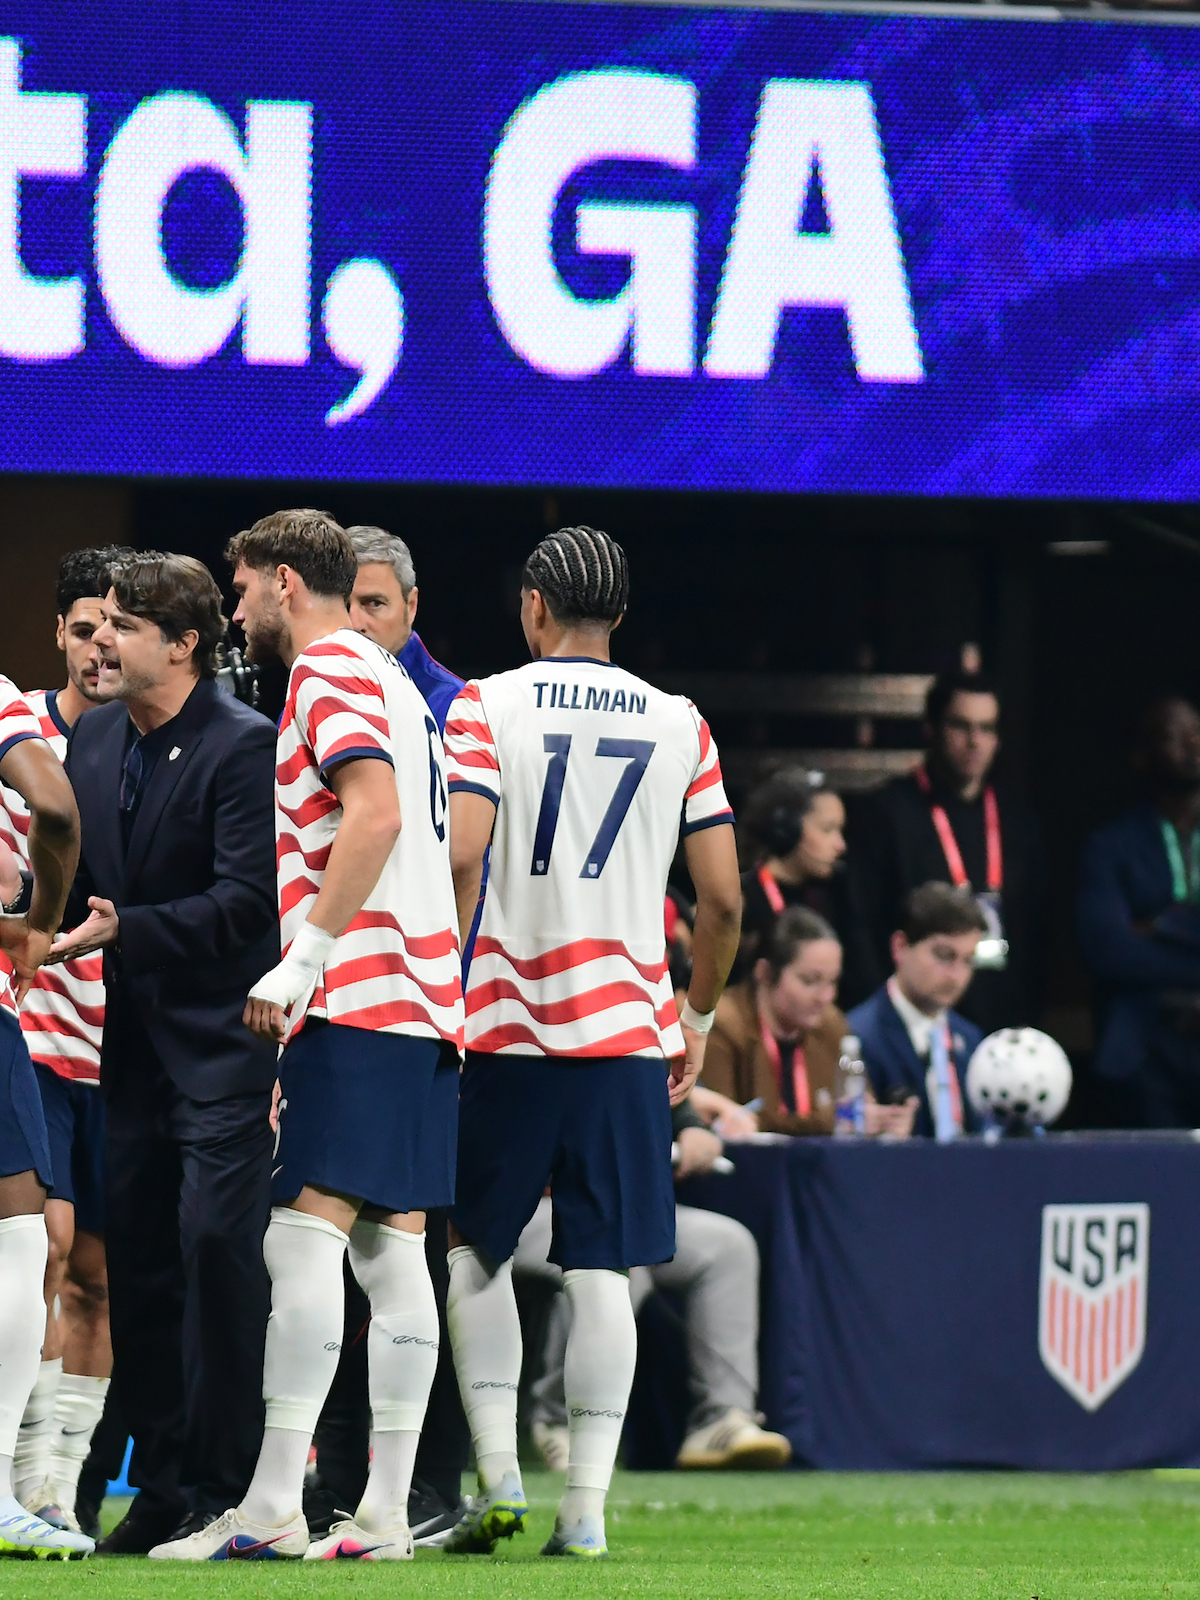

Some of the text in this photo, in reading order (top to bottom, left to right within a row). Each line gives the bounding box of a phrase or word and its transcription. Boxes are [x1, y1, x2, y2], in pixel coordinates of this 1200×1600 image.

[483, 66, 926, 383] GA
[533, 682, 647, 714] TILLMAN
[530, 733, 657, 879] 17
[1052, 1216, 1138, 1288] USA
